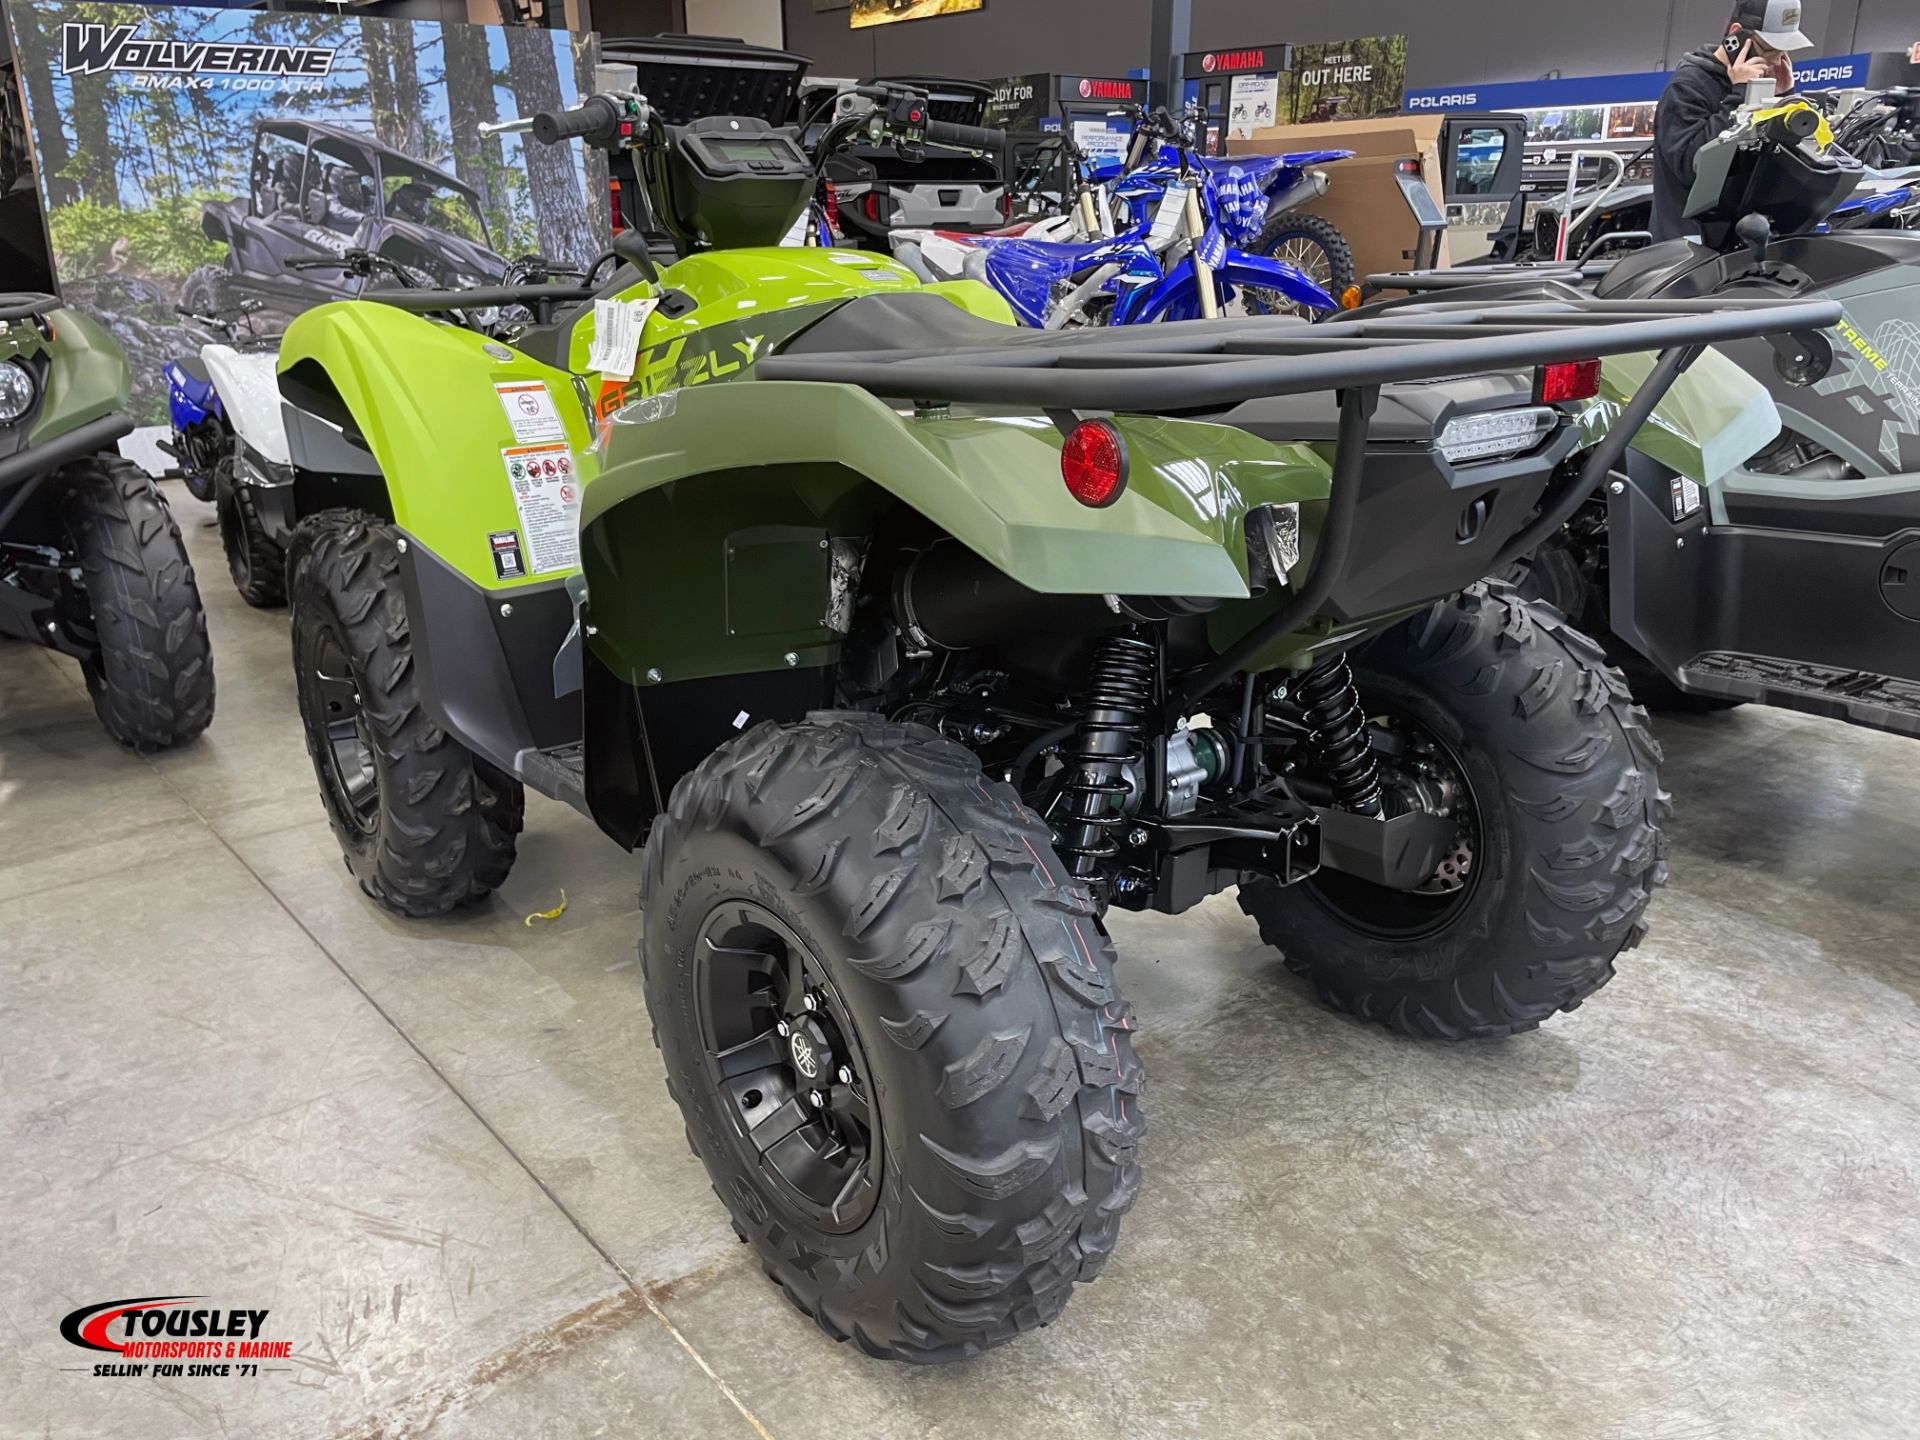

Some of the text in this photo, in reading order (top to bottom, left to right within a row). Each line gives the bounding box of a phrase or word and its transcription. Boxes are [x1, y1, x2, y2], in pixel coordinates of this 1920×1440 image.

[62, 22, 337, 77] WOLVERINE
[1216, 51, 1264, 70] YAMAHA
[1324, 57, 1341, 65] MEET
[1302, 65, 1373, 86] OUT HERE
[1793, 65, 1853, 83] POLARIS
[132, 75, 325, 93] RMAX4 1000 XT-R
[1091, 81, 1132, 98] YAMAHA
[988, 86, 1033, 102] ADY FOR
[1409, 93, 1477, 108] POLARIS
[1835, 319, 1889, 372] TREME
[600, 334, 765, 418] GRIZZLY
